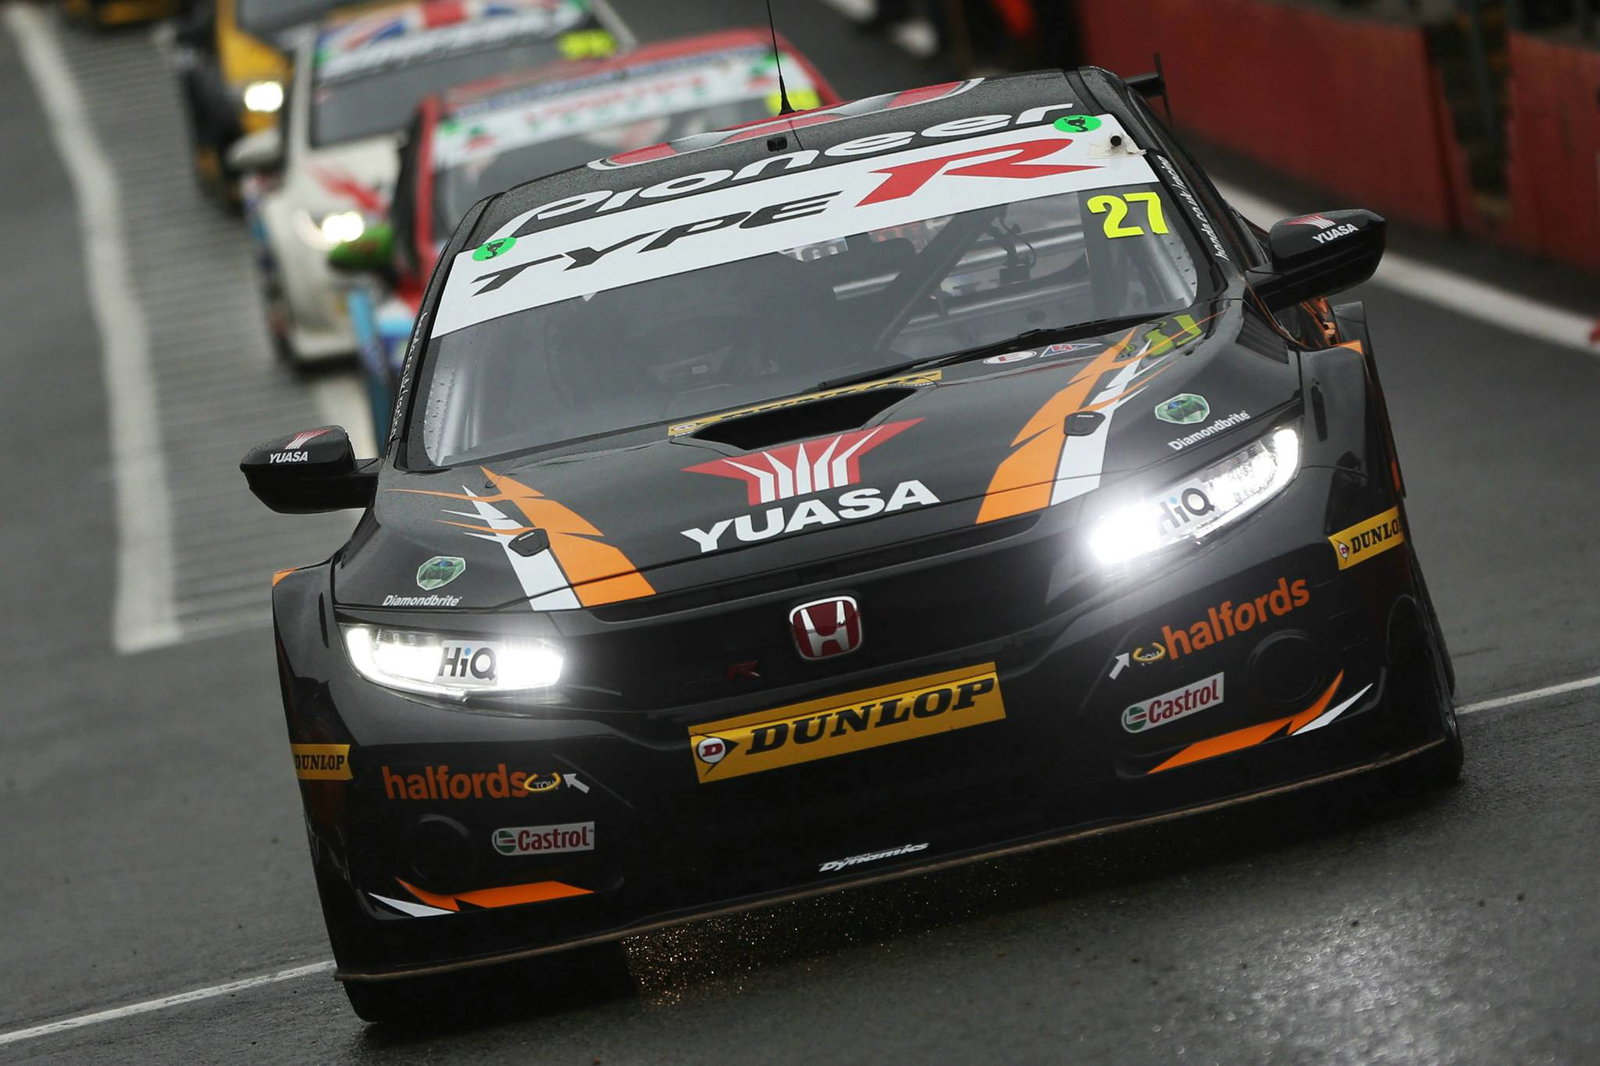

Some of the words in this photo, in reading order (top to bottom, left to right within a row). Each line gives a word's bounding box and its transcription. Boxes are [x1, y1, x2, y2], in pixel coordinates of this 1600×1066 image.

[481, 103, 1073, 241] pioneer
[471, 191, 843, 297] TYPE
[854, 138, 1106, 208] R
[1087, 192, 1169, 238] 27
[1312, 223, 1359, 244] YUASA
[1168, 411, 1250, 450] Diamondbrite
[269, 451, 309, 463] YUASA
[680, 479, 941, 553] YUASA
[1351, 518, 1399, 553] DUNLO
[382, 594, 462, 607] Diamondbrite
[1161, 577, 1310, 660] halfords
[438, 647, 497, 681] HiQ
[745, 677, 995, 755] DUNLOP
[1149, 678, 1219, 724] Castrol
[295, 754, 345, 770] DUNLOP
[382, 763, 529, 799] halfords
[518, 826, 589, 851] Castrol
[819, 842, 929, 872] Dynamics
